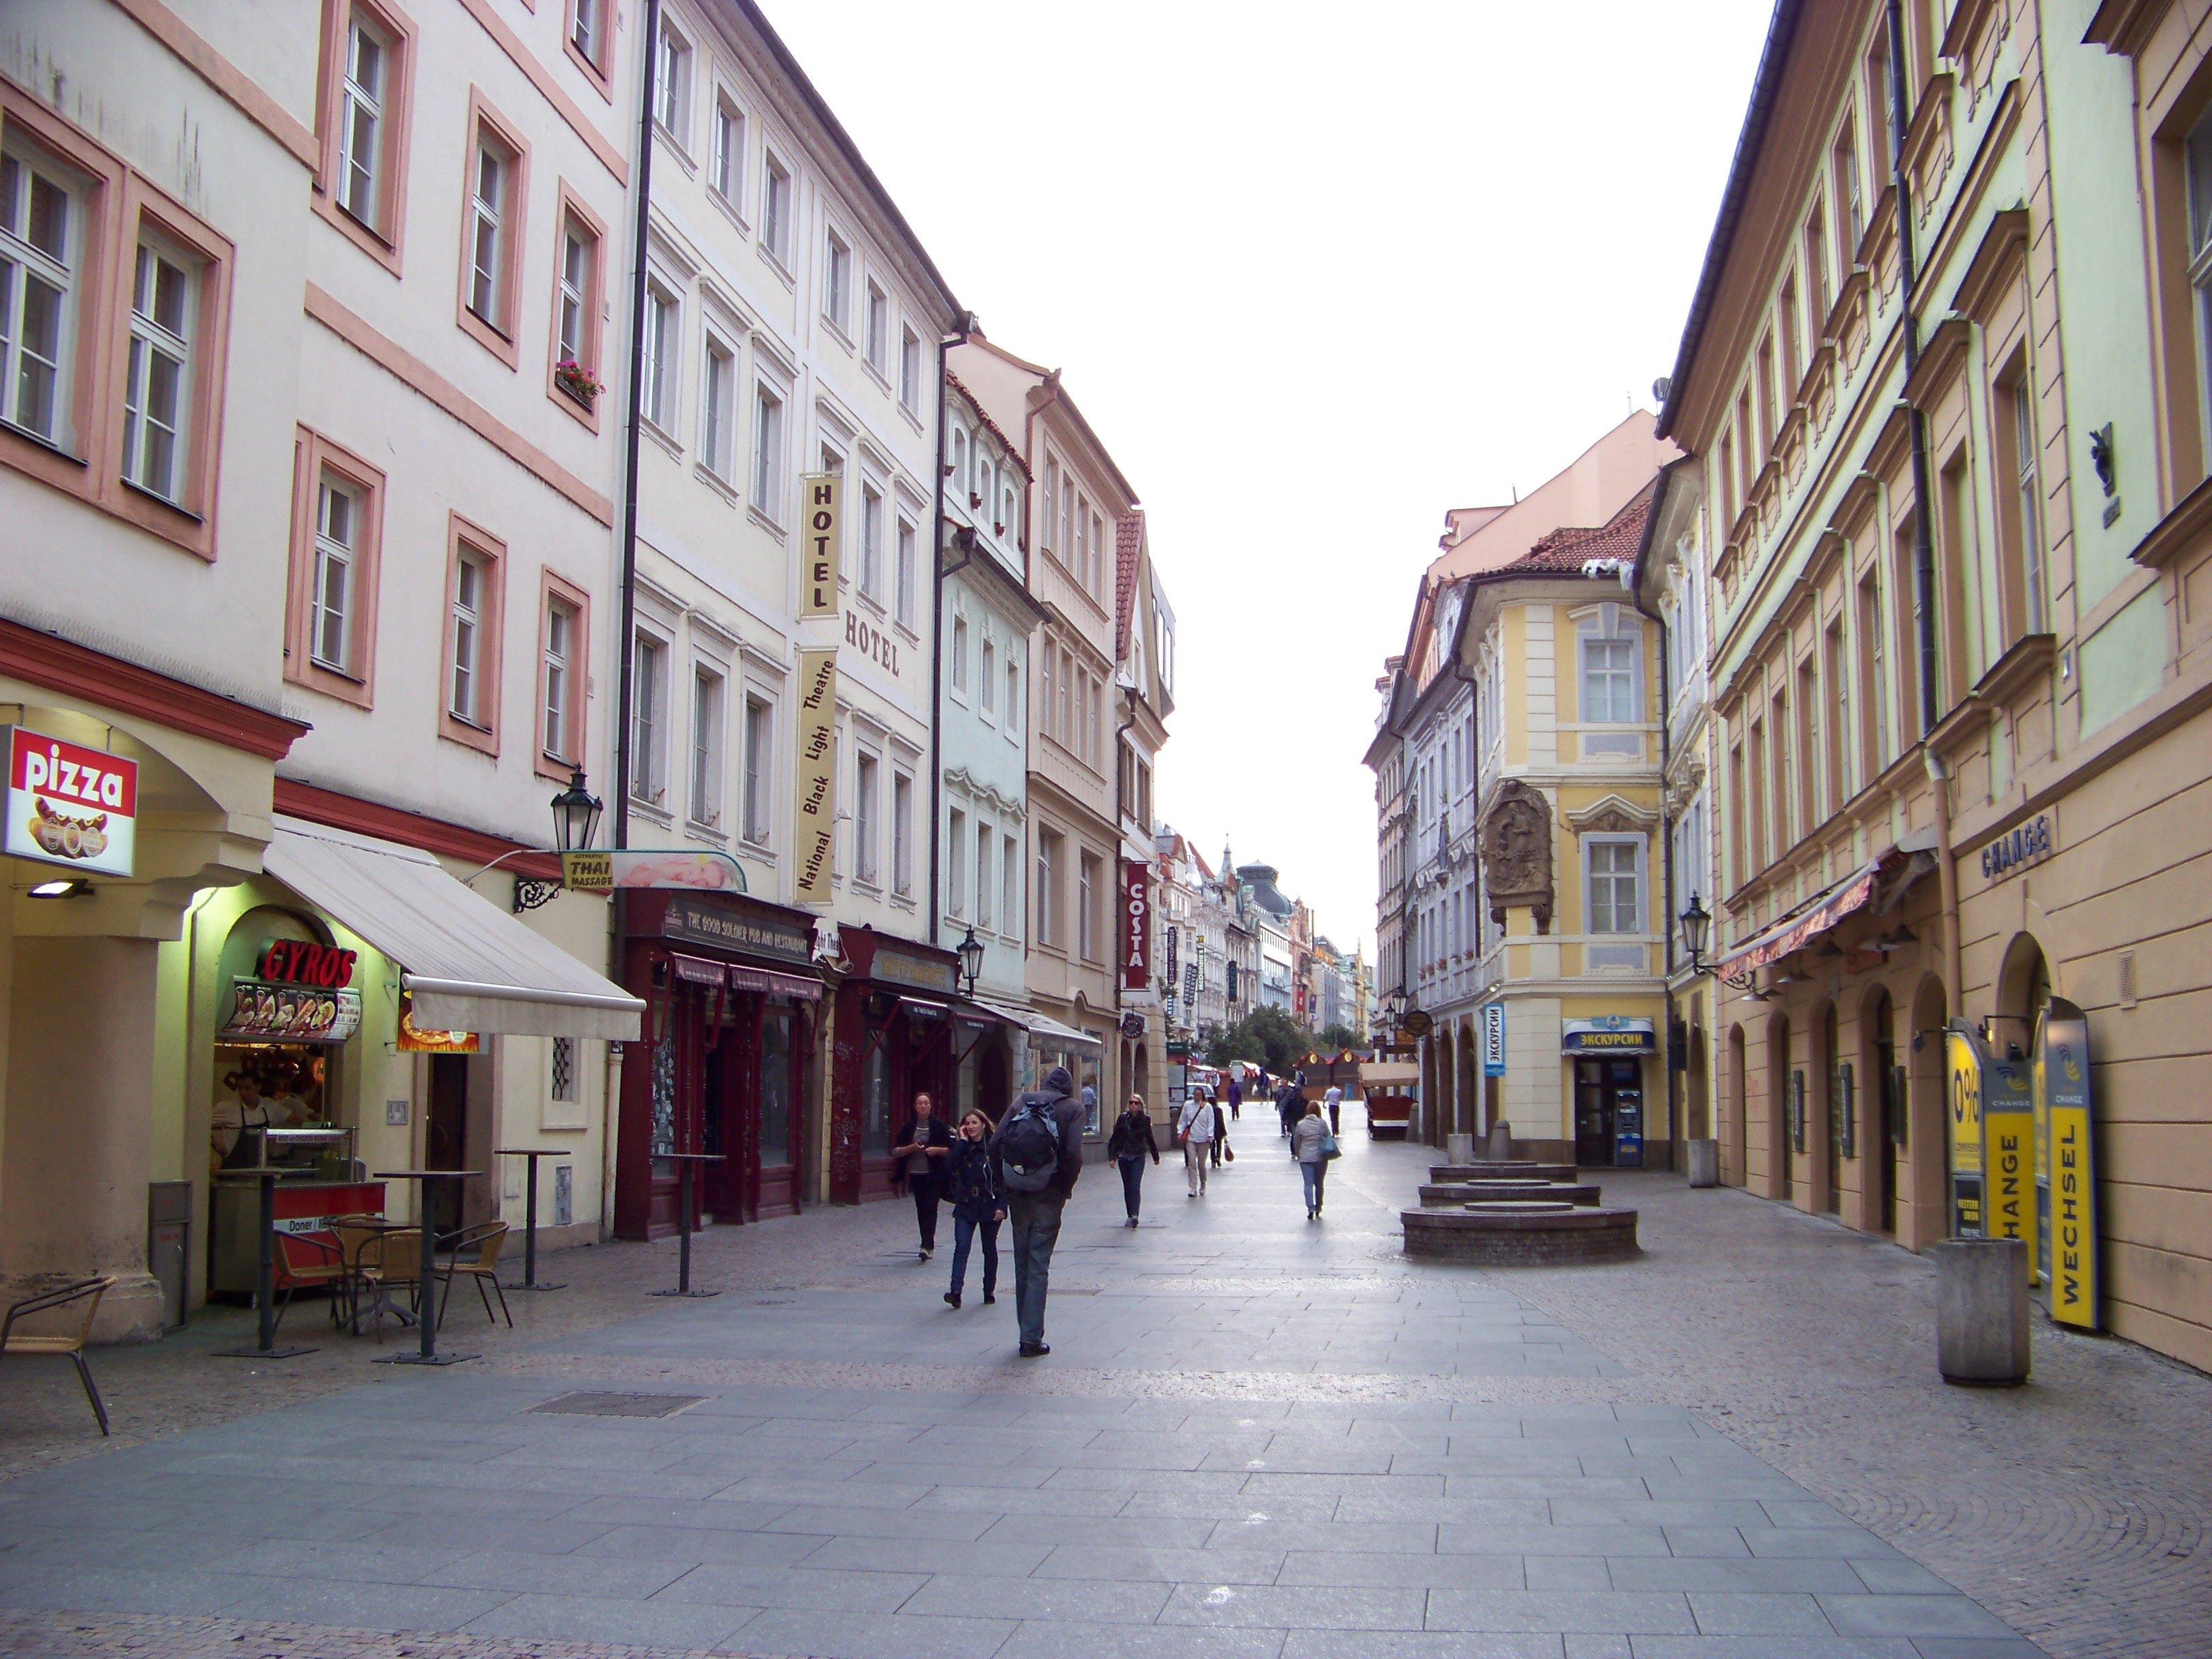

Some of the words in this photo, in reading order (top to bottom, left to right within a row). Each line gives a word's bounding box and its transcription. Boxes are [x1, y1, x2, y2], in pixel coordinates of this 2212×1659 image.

[813, 485, 832, 607] HOTEL
[845, 609, 899, 678] HOTEL
[803, 660, 834, 710] Theatre
[804, 726, 830, 760] Light
[25, 744, 123, 807] pizza
[803, 776, 829, 815] Black
[571, 861, 611, 875] THAI
[798, 831, 831, 890] National
[1982, 815, 2047, 879] CHANGE
[571, 877, 613, 886] MASSAGE
[688, 912, 701, 930] THE
[702, 916, 720, 934] GOOD
[722, 920, 747, 943] SOLDIER
[749, 927, 760, 943] PUB
[762, 930, 773, 946] AND
[774, 933, 808, 954] RESTAURANT
[1129, 884, 1145, 967] COSTA
[263, 939, 358, 988] GYROS
[1189, 968, 1197, 1003] RESERVED
[1490, 1009, 1499, 1061] ЭКСКУРСИИ
[1580, 1034, 1643, 1045] ЭКСКУРСИИ
[1954, 1067, 1978, 1124] 0%
[2055, 1094, 2083, 1104] CHANGE
[2001, 1135, 2020, 1238] HANGE
[289, 1221, 312, 1232] Doner
[2061, 1124, 2079, 1306] WECHSEL
